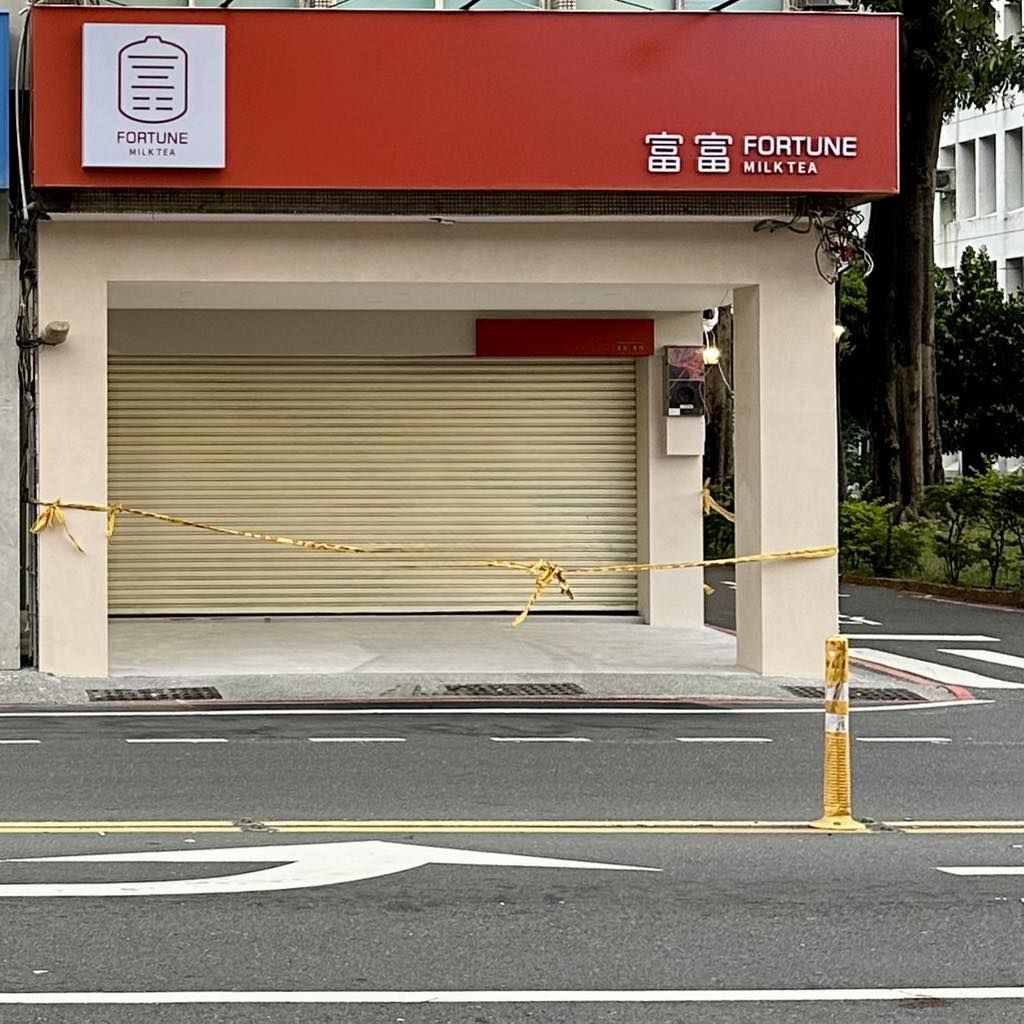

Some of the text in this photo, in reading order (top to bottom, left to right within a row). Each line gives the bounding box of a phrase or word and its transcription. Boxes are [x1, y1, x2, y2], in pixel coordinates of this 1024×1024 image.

[117, 131, 188, 145] FORTUNE
[743, 135, 858, 156] FORTUNE
[645, 131, 733, 173] 富富
